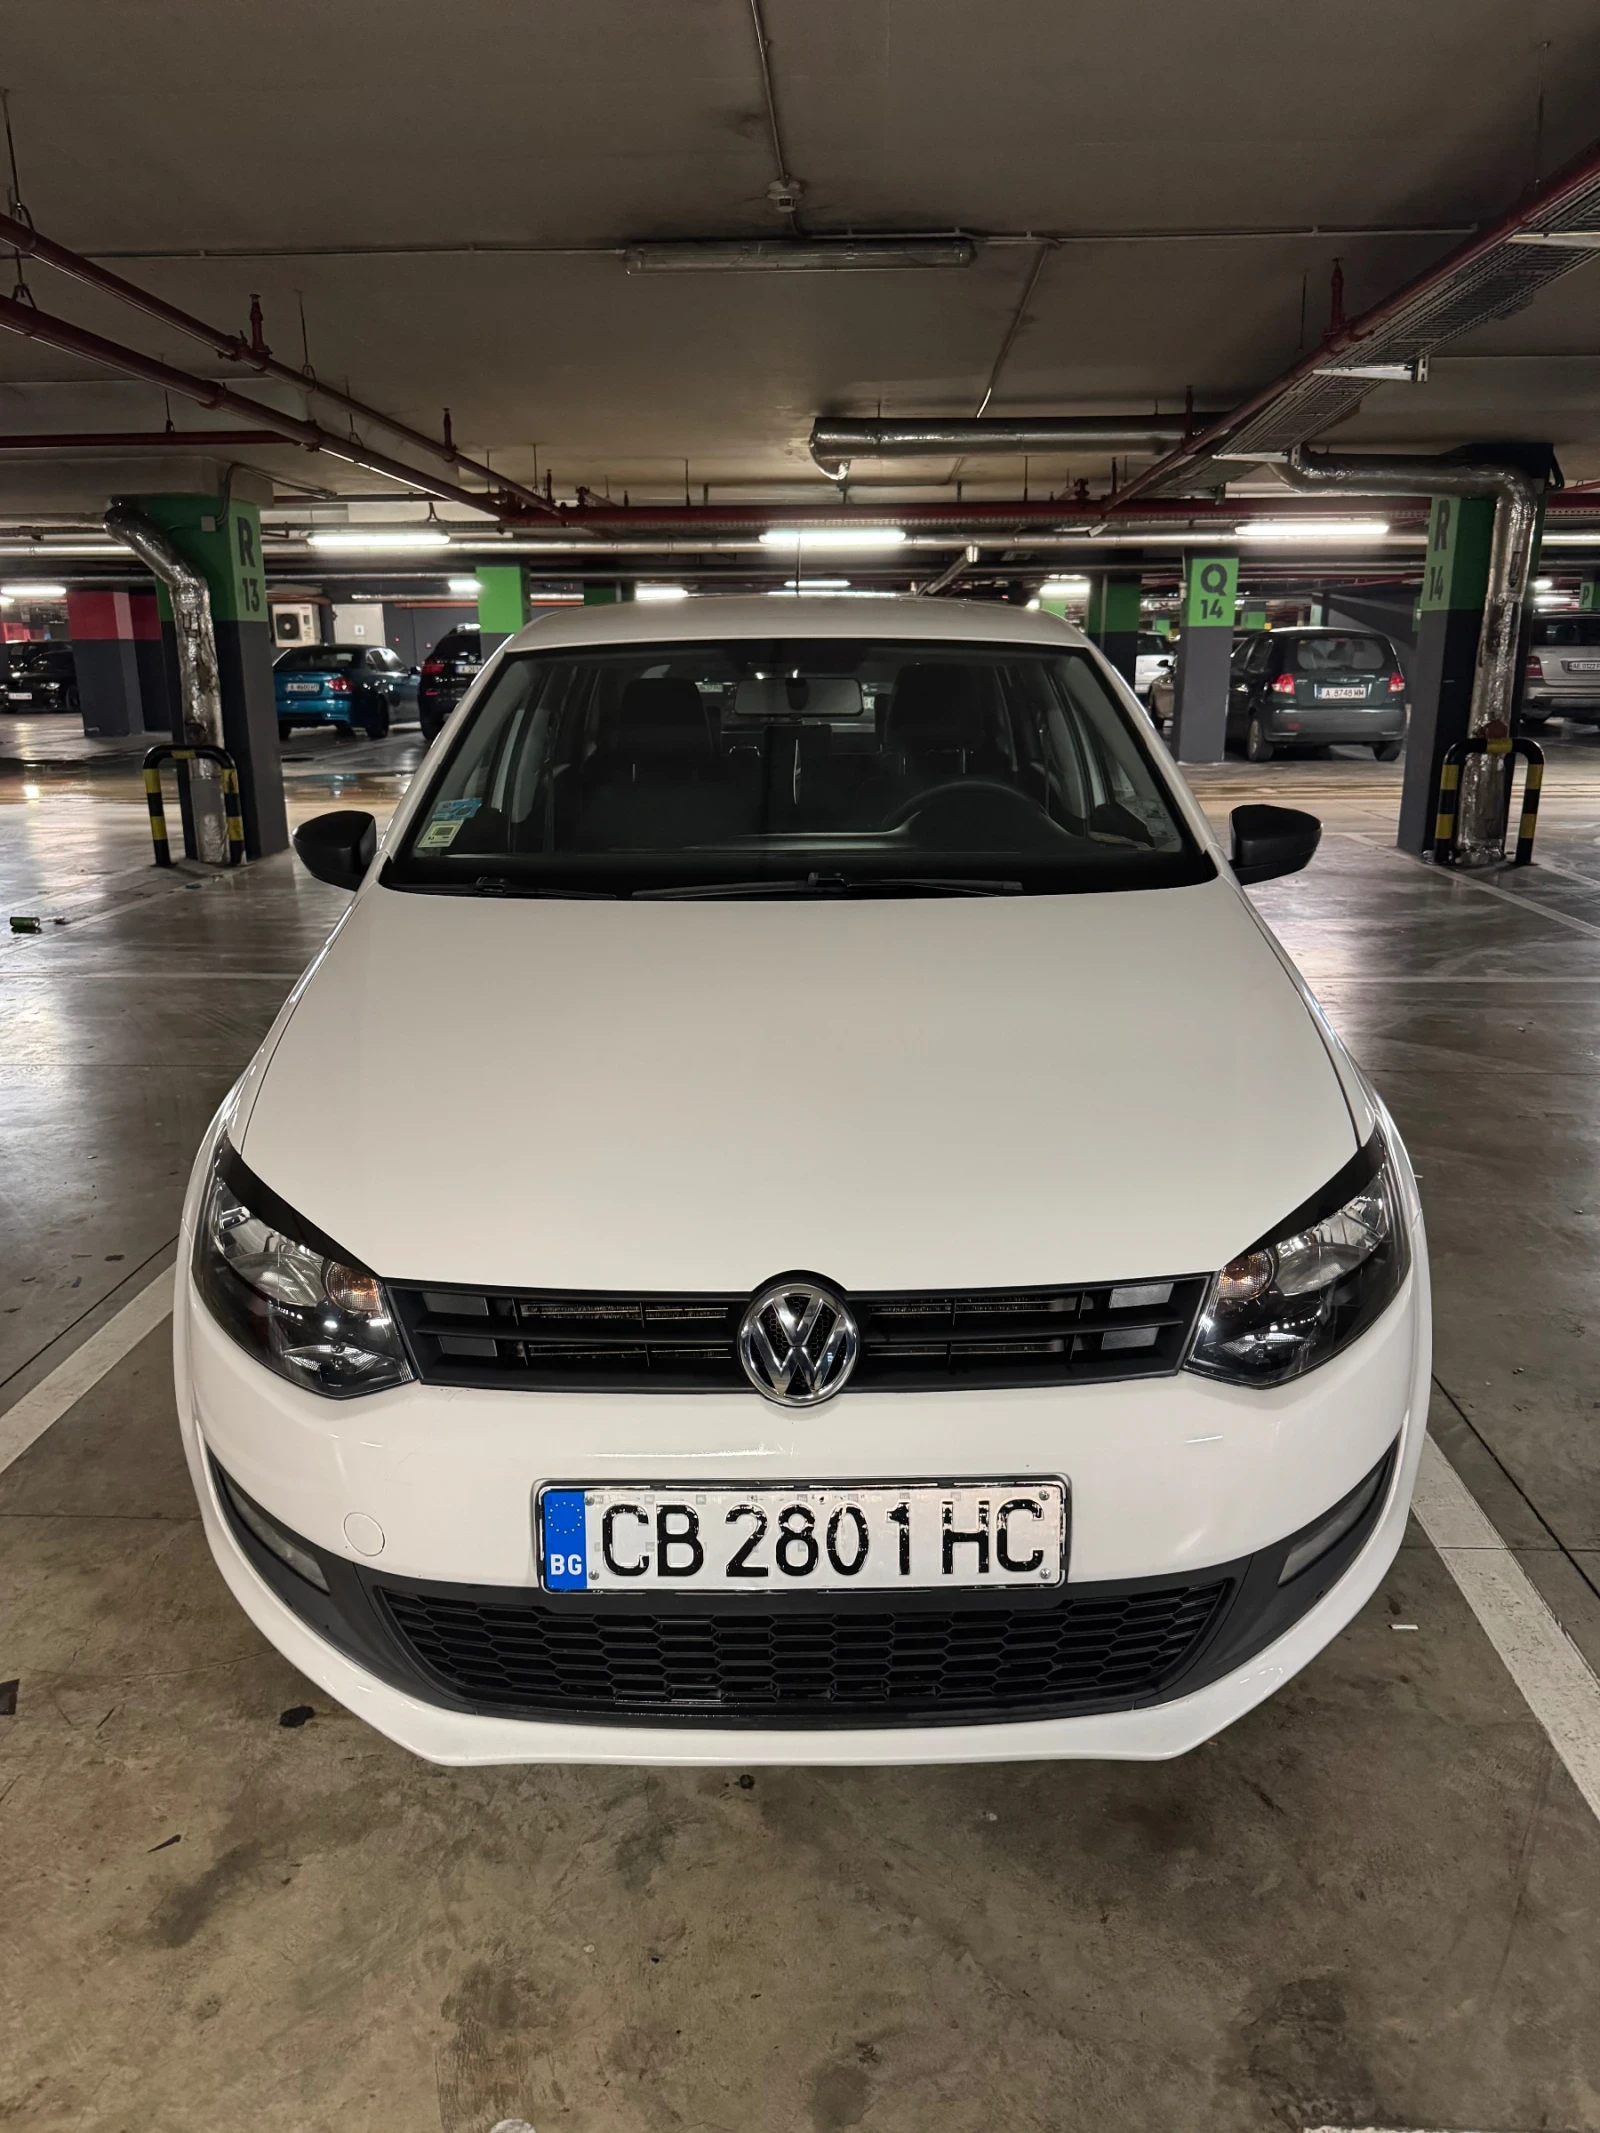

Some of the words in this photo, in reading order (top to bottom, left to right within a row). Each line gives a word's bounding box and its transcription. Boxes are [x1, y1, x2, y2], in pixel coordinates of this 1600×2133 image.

[237, 516, 256, 568] R
[1433, 499, 1450, 552] R
[242, 578, 260, 612] 13
[1200, 563, 1227, 597] Q
[1430, 566, 1443, 601] 14
[1201, 599, 1223, 620] 14
[602, 1503, 704, 1577] CB
[726, 1503, 911, 1577] 2801
[941, 1499, 1045, 1575] HC
[551, 1554, 582, 1575] BG
